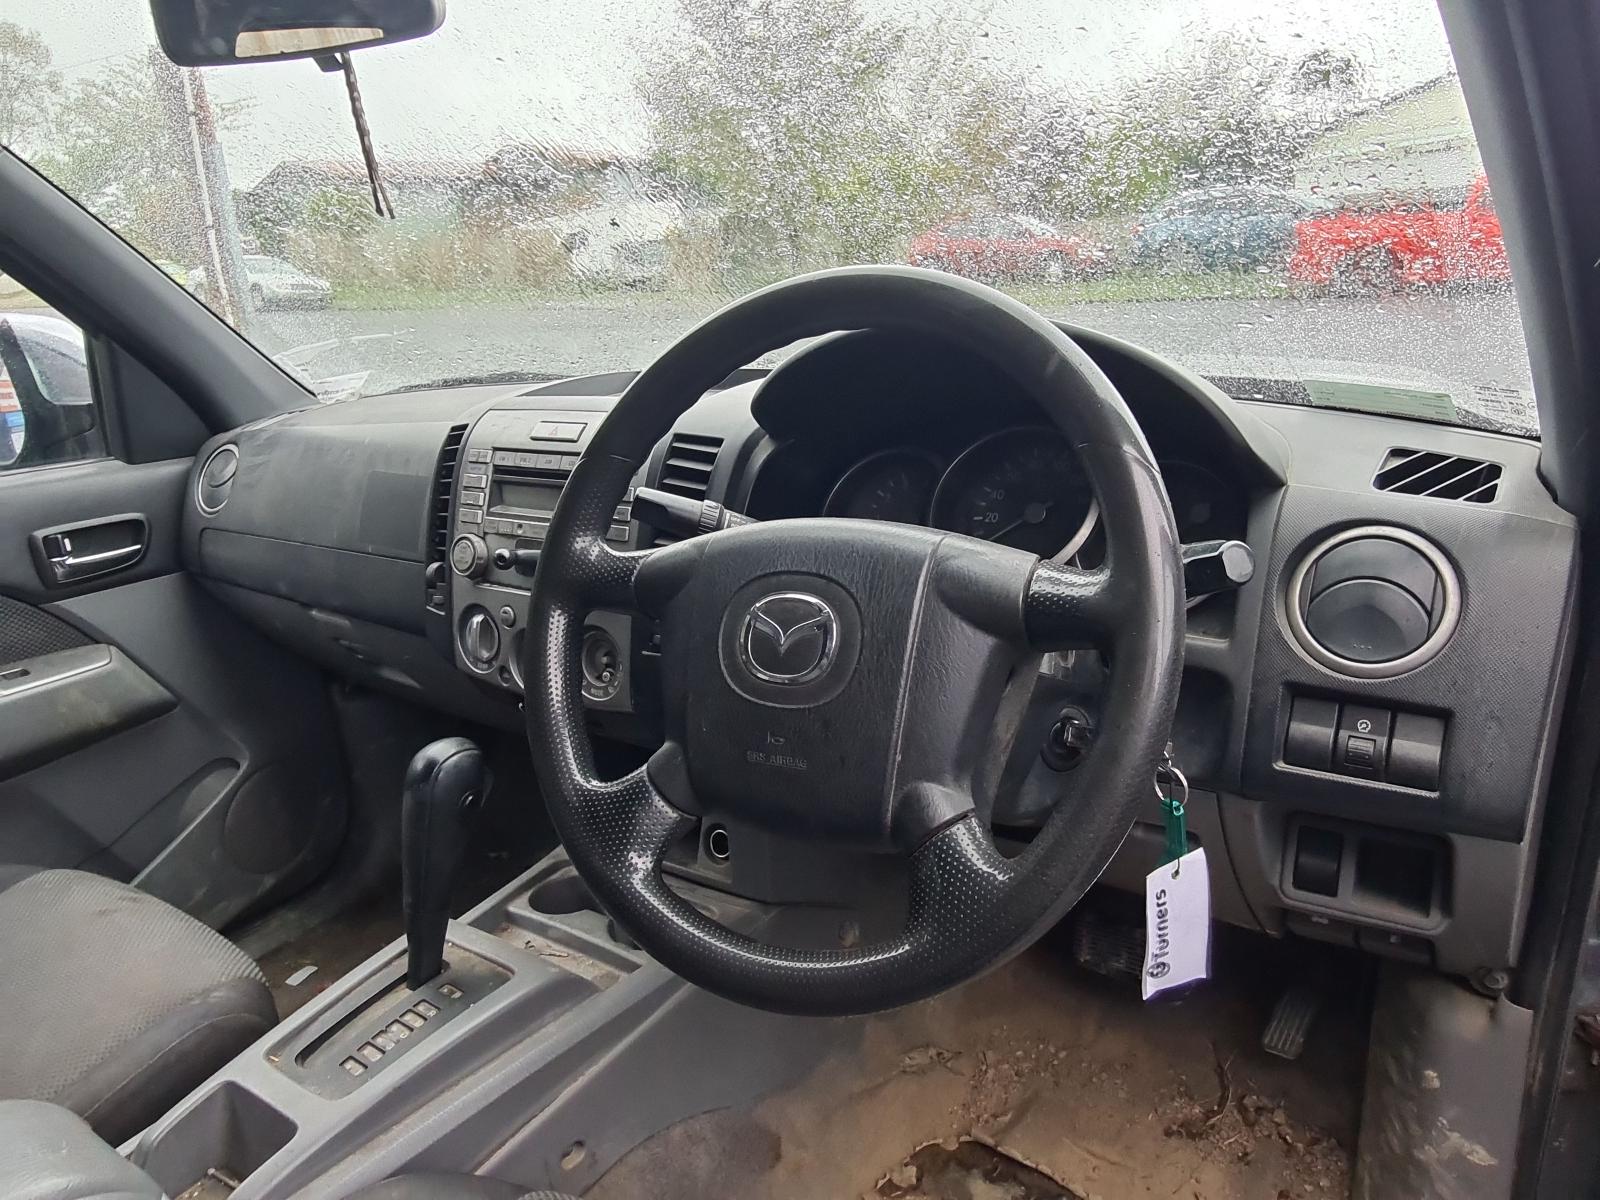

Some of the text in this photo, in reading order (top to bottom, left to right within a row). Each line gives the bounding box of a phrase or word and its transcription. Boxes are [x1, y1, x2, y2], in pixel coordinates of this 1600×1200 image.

[984, 512, 999, 524] 20
[769, 754, 808, 769] AIRBAG
[1151, 888, 1170, 963] Turners
